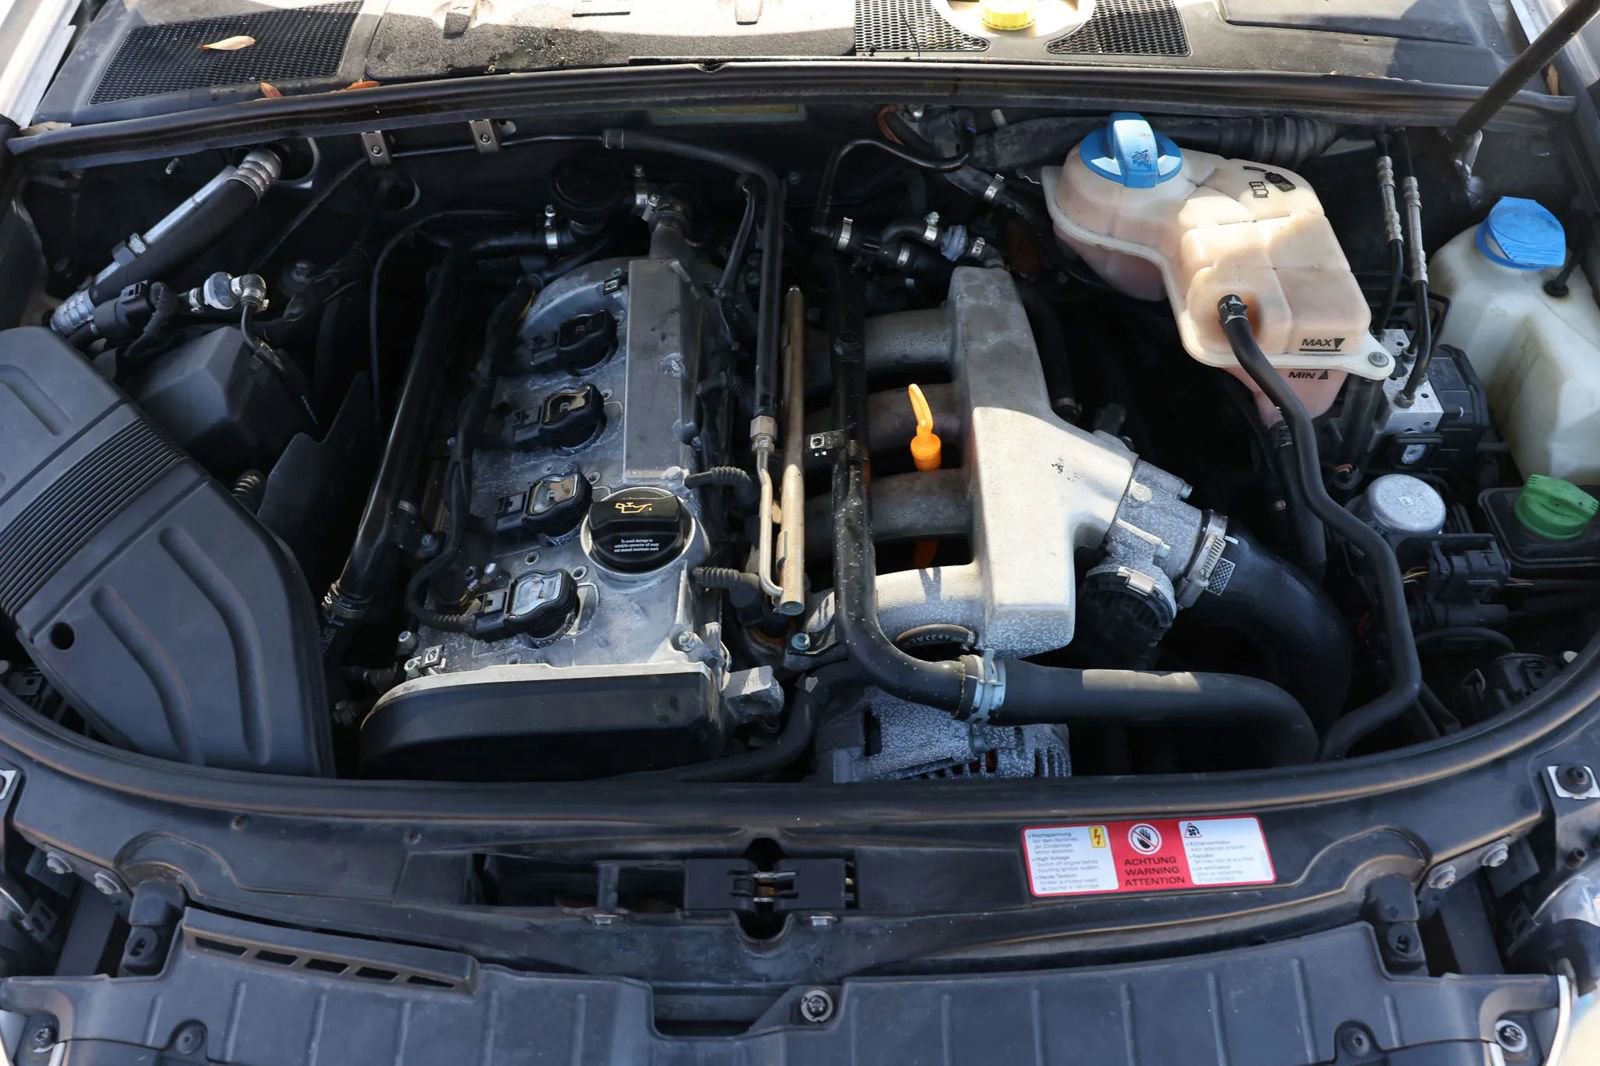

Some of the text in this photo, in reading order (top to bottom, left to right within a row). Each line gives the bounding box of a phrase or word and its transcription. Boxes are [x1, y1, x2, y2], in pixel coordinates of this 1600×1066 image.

[1301, 338, 1332, 347] MAX
[1288, 371, 1316, 379] MIN
[1124, 856, 1177, 866] ACHTUNG
[1125, 866, 1180, 876] WARNING
[1125, 876, 1185, 887] ATTENTION
